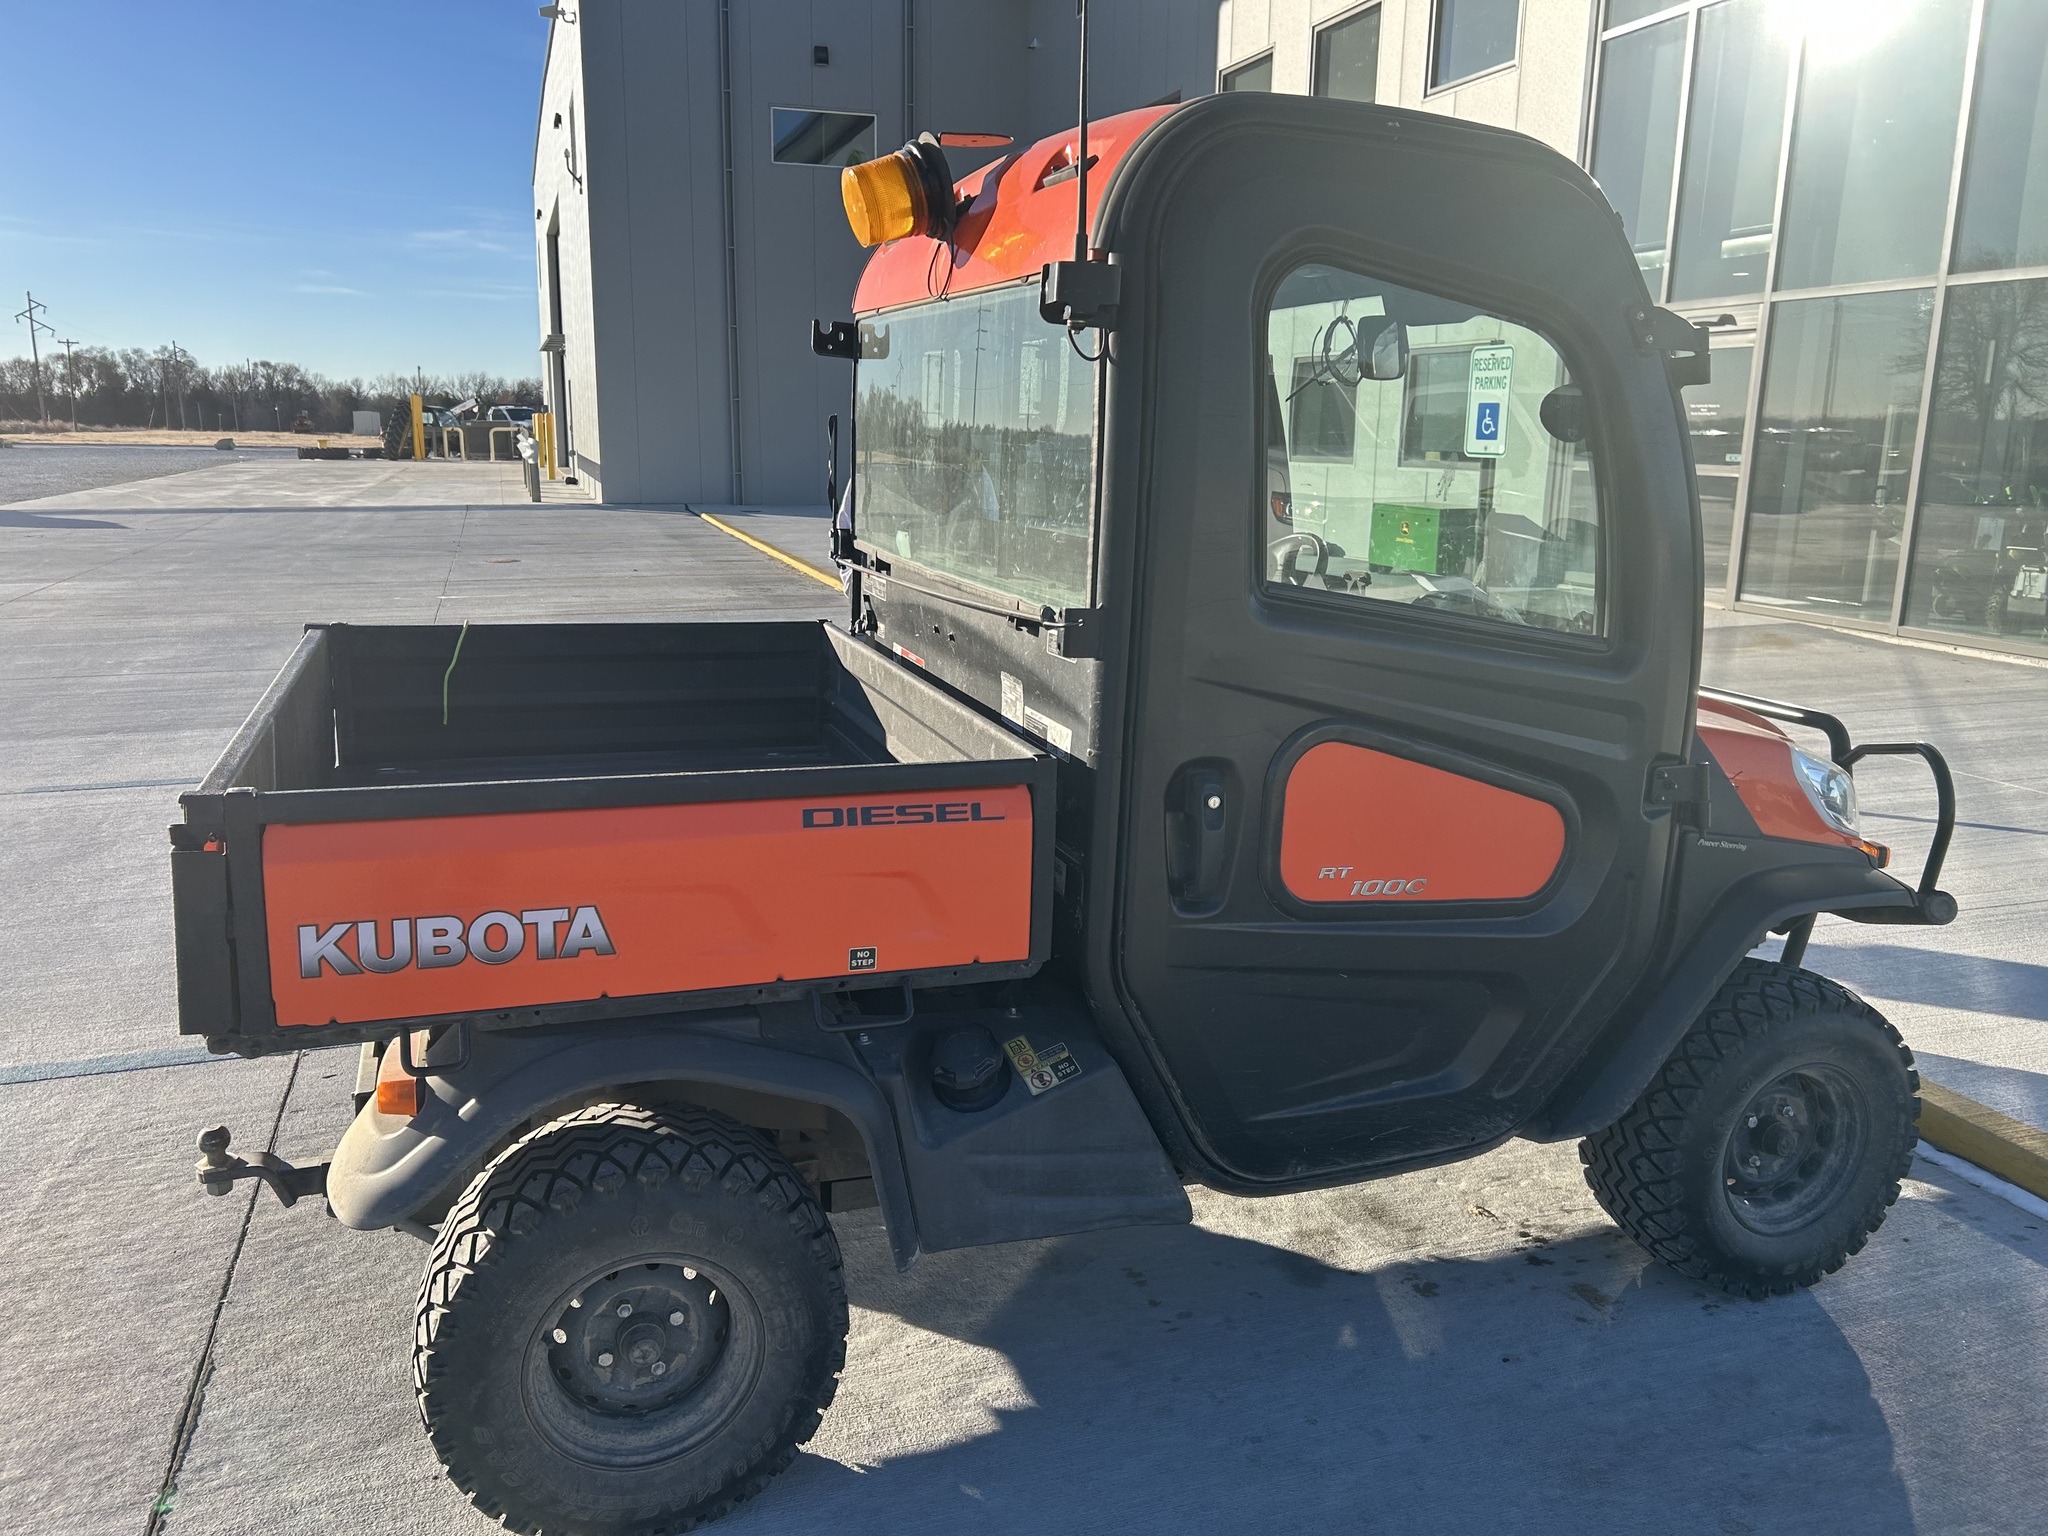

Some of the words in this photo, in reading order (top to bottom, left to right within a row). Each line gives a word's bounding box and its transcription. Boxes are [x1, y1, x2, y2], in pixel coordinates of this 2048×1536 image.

[1473, 356, 1511, 371] RESERVED
[1475, 376, 1507, 390] PARKING
[802, 802, 1006, 829] DIESEL
[1697, 838, 1719, 848] Power
[1719, 840, 1747, 851] Steering
[1318, 866, 1354, 879] RT
[1350, 878, 1427, 896] 100C
[297, 905, 616, 979] KUBOTA
[857, 950, 870, 958] NO
[851, 958, 874, 967] STEP
[1057, 1062, 1069, 1071] NO
[1057, 1065, 1076, 1077] STEP
